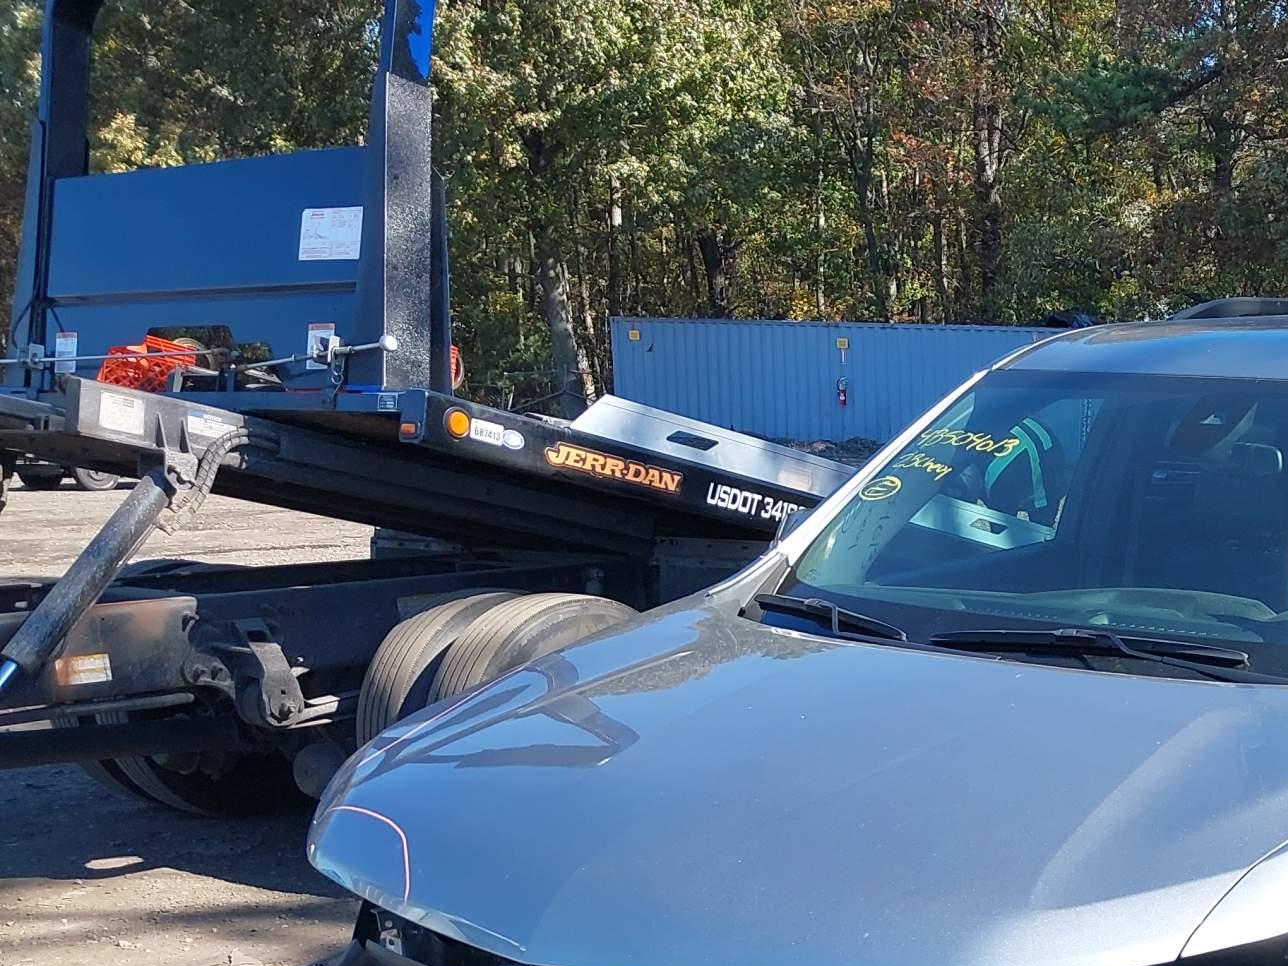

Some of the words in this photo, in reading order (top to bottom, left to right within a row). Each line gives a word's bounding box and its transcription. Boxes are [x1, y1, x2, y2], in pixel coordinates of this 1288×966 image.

[916, 428, 1020, 457] 43504013
[545, 441, 683, 494] JERR-DAN
[706, 482, 763, 516] USDOT
